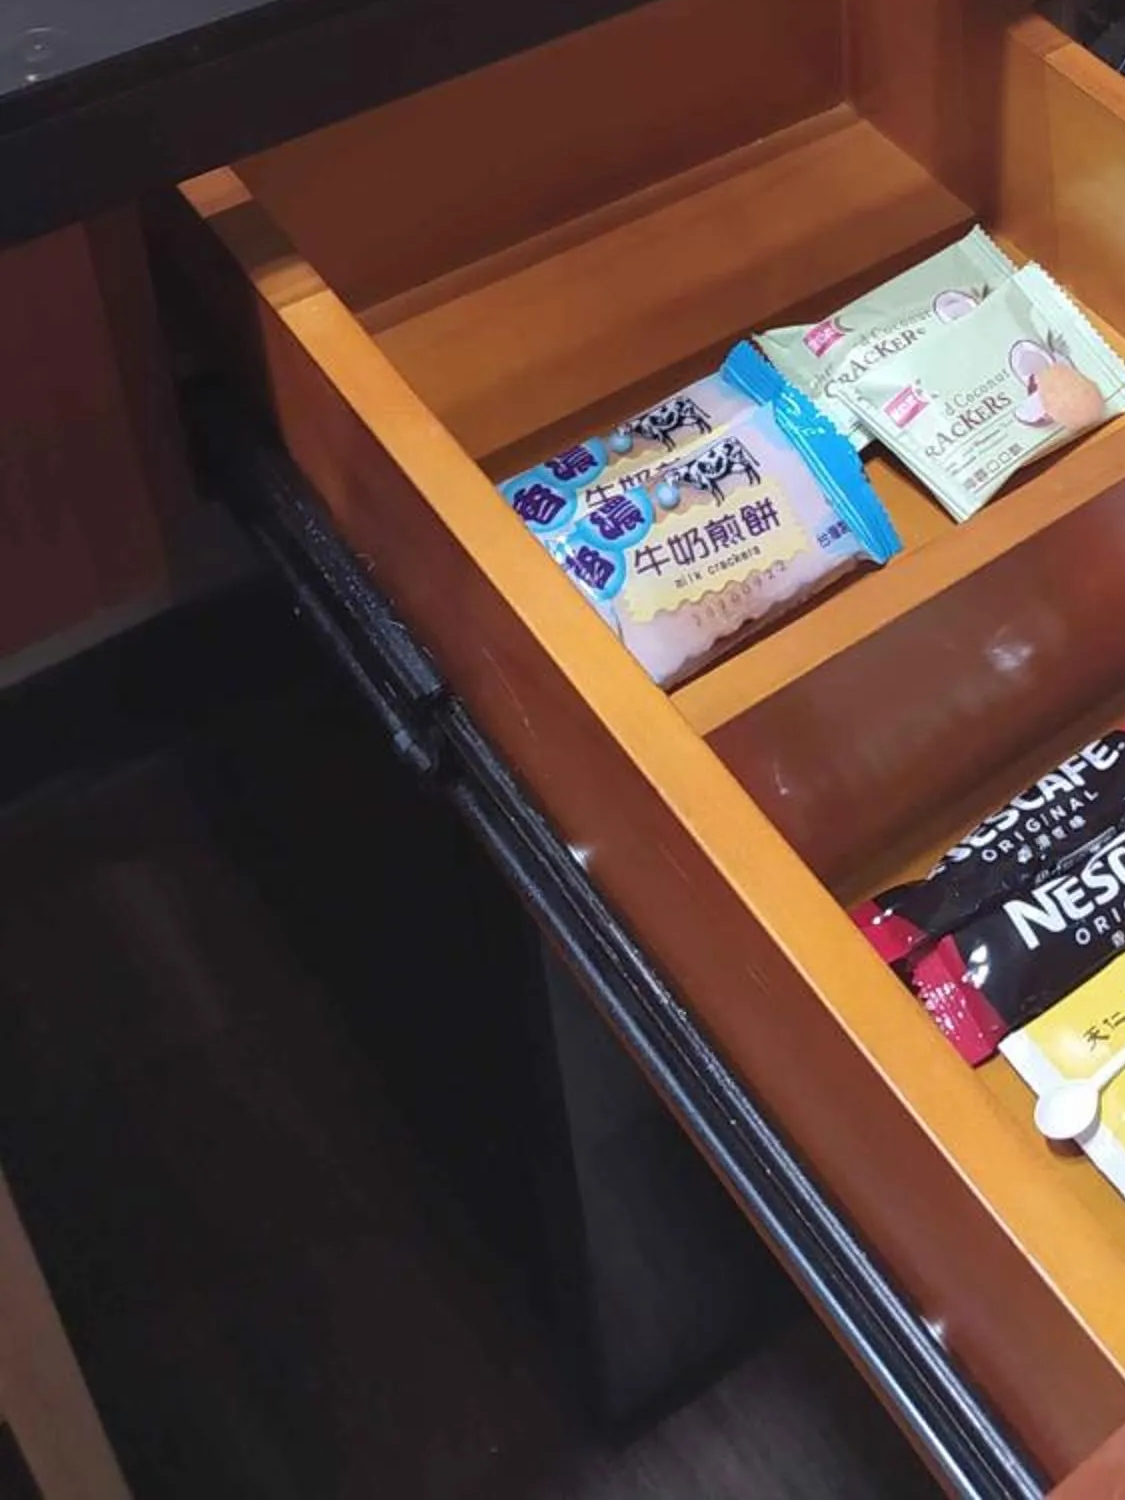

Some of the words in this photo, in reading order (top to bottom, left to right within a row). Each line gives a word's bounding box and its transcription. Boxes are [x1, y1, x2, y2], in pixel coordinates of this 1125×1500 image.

[924, 391, 1012, 457] RACKERS
[633, 497, 782, 577] 牛奶煎餅
[674, 571, 703, 590] milk
[707, 546, 762, 576] crackers
[981, 788, 1100, 864] ORIGINAL
